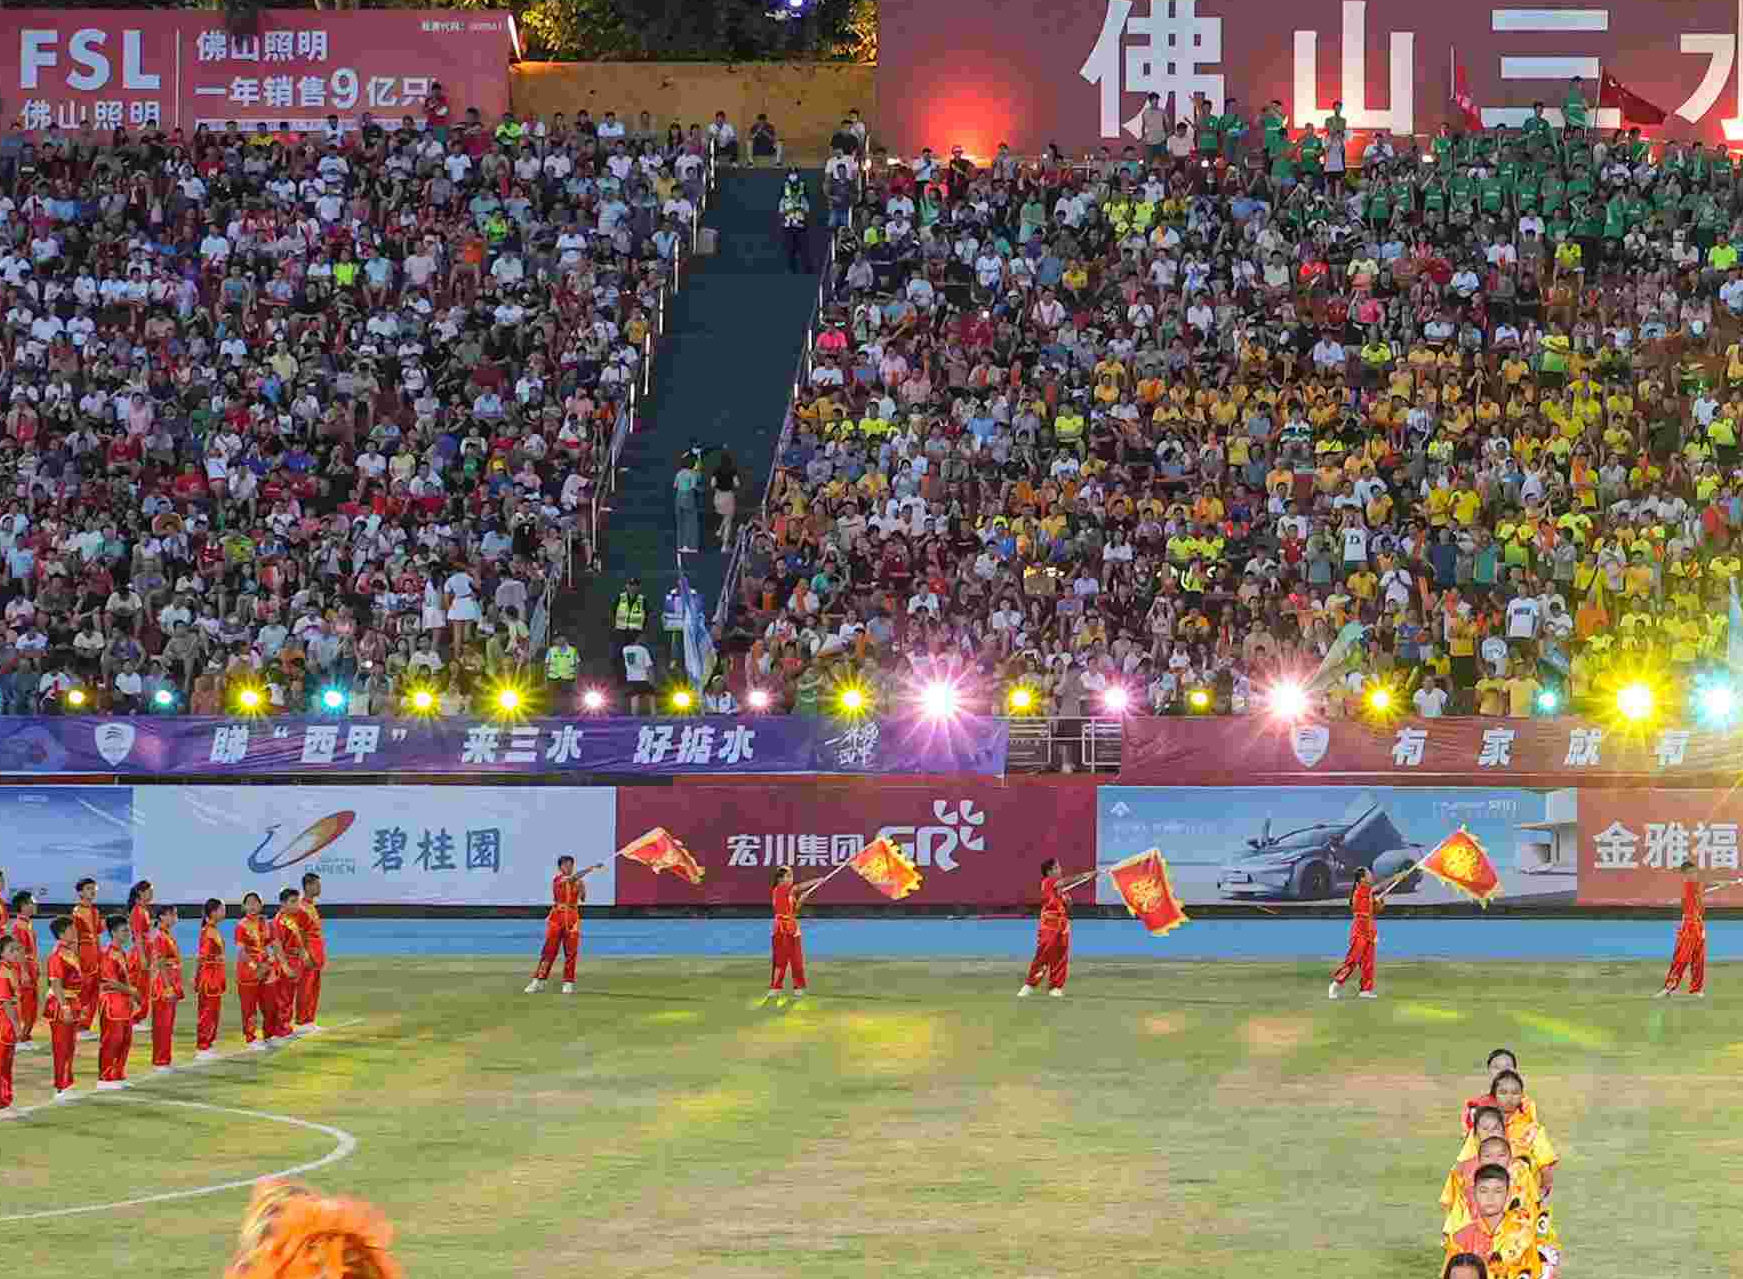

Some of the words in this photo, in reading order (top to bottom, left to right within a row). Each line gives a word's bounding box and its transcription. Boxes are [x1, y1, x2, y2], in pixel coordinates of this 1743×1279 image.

[20, 29, 161, 90] FSL
[196, 30, 328, 61] 佛山照明
[194, 68, 437, 110] 一年销售9亿只
[21, 99, 162, 131] 佛山照明
[461, 725, 583, 764] 来三水
[727, 832, 865, 868] 宏川集团
